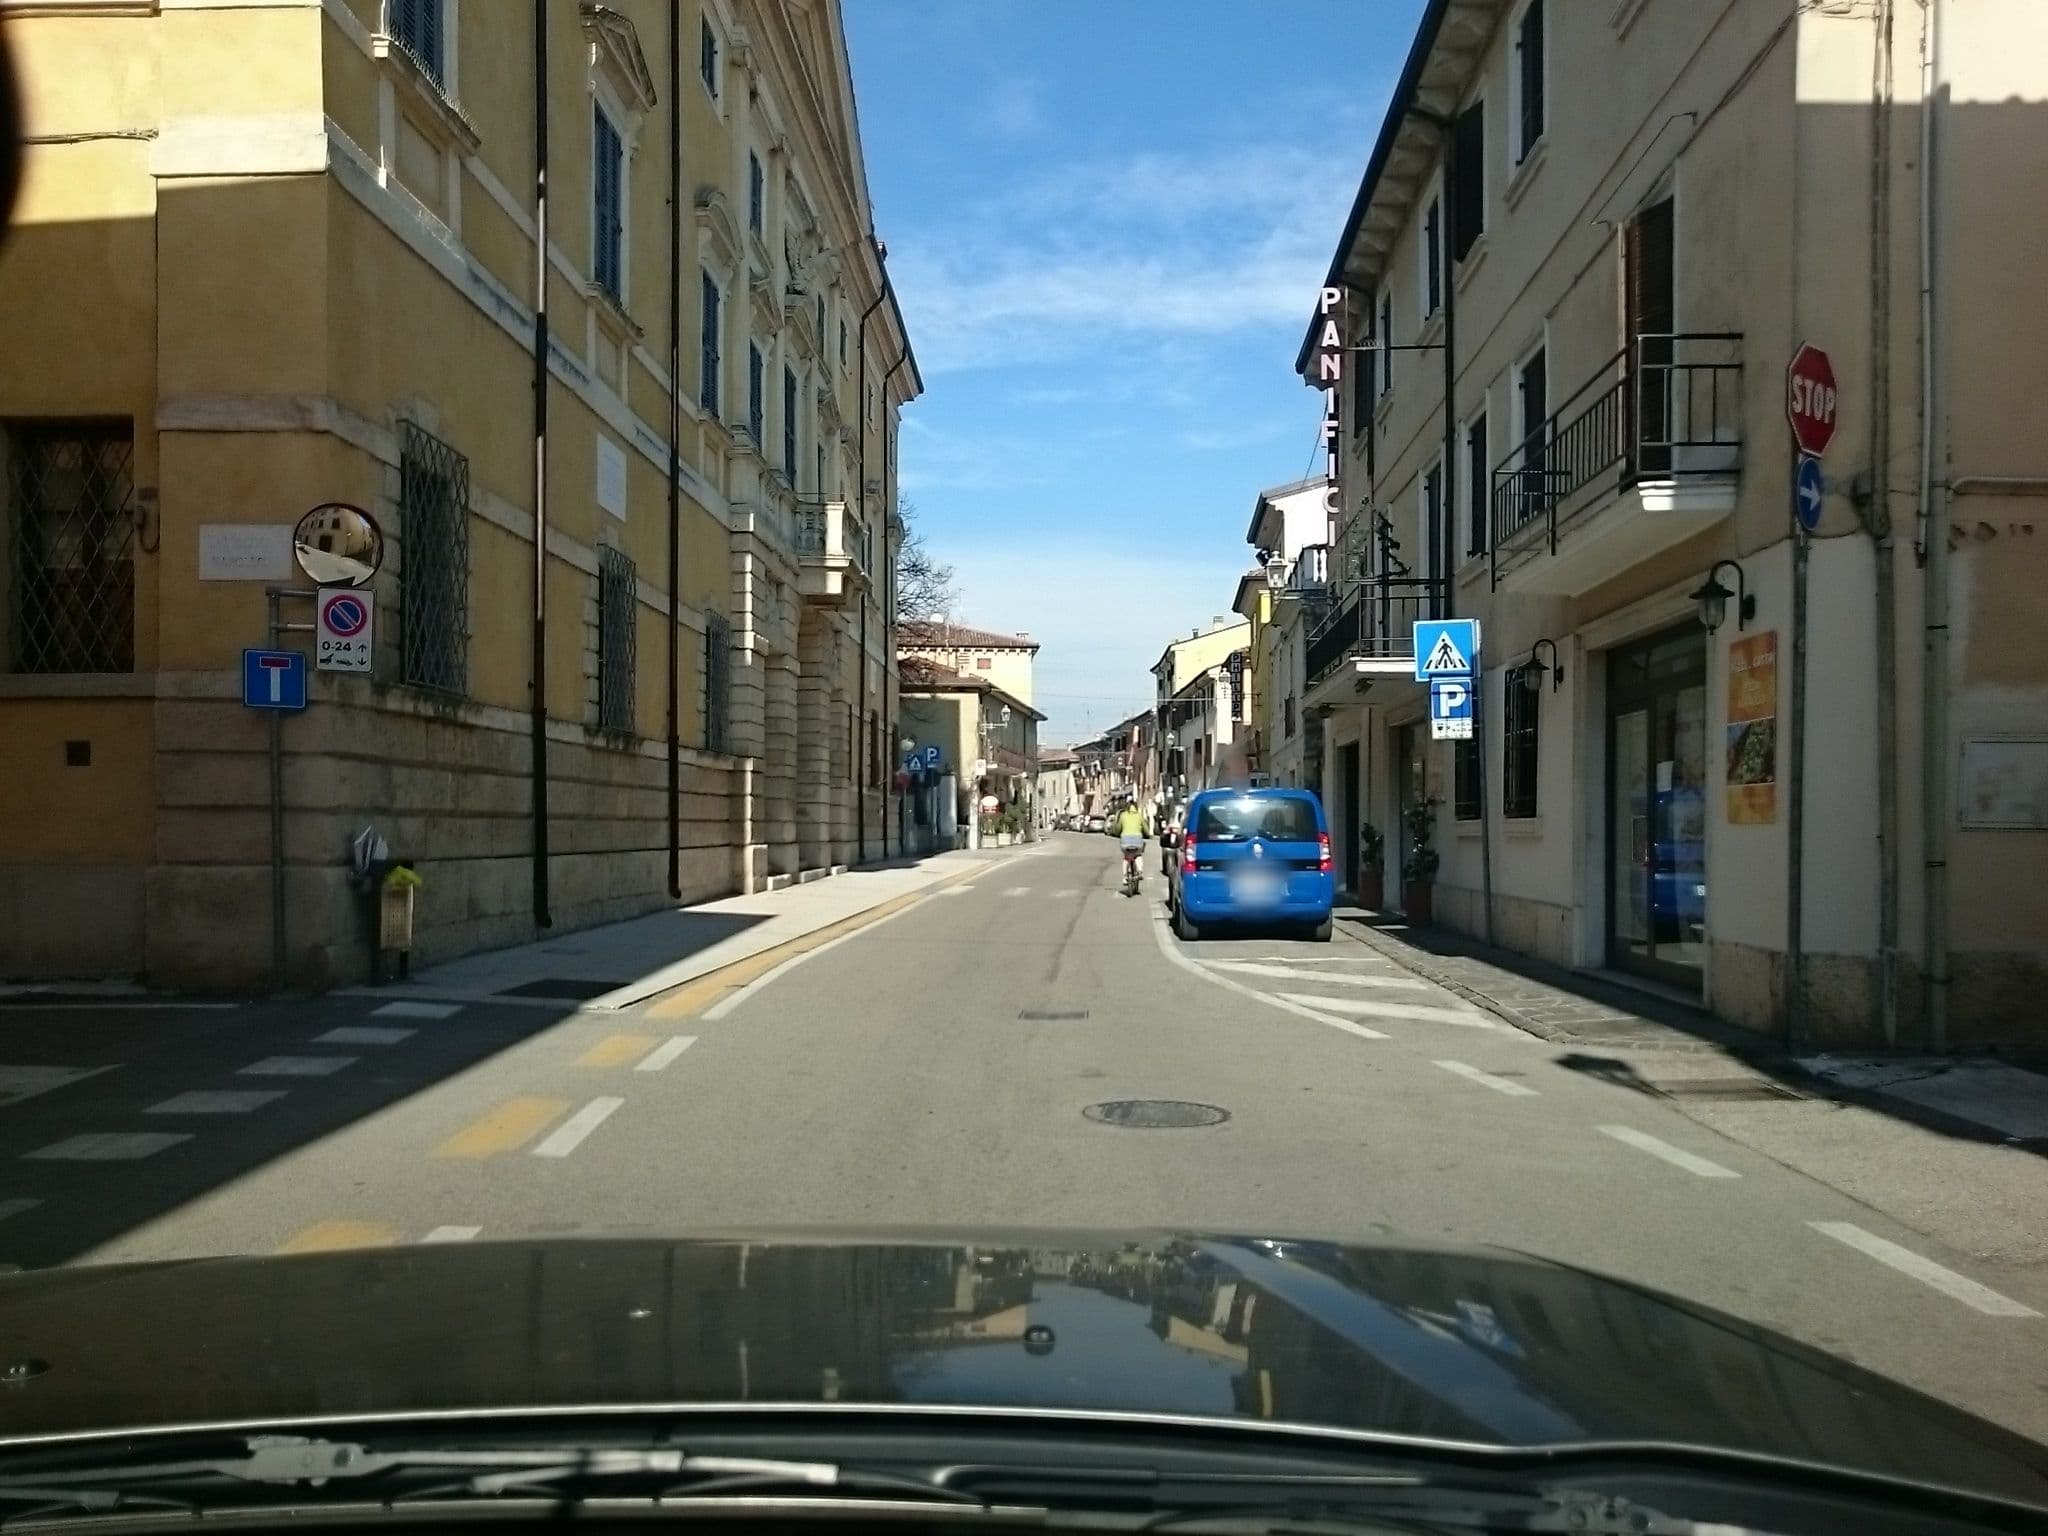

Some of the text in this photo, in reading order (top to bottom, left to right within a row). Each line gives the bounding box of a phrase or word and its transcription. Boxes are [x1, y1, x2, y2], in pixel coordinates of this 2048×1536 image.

[1791, 373, 1836, 424] STOP
[321, 641, 352, 652] 0-24
[1439, 684, 1467, 717] P
[927, 748, 938, 761] P
